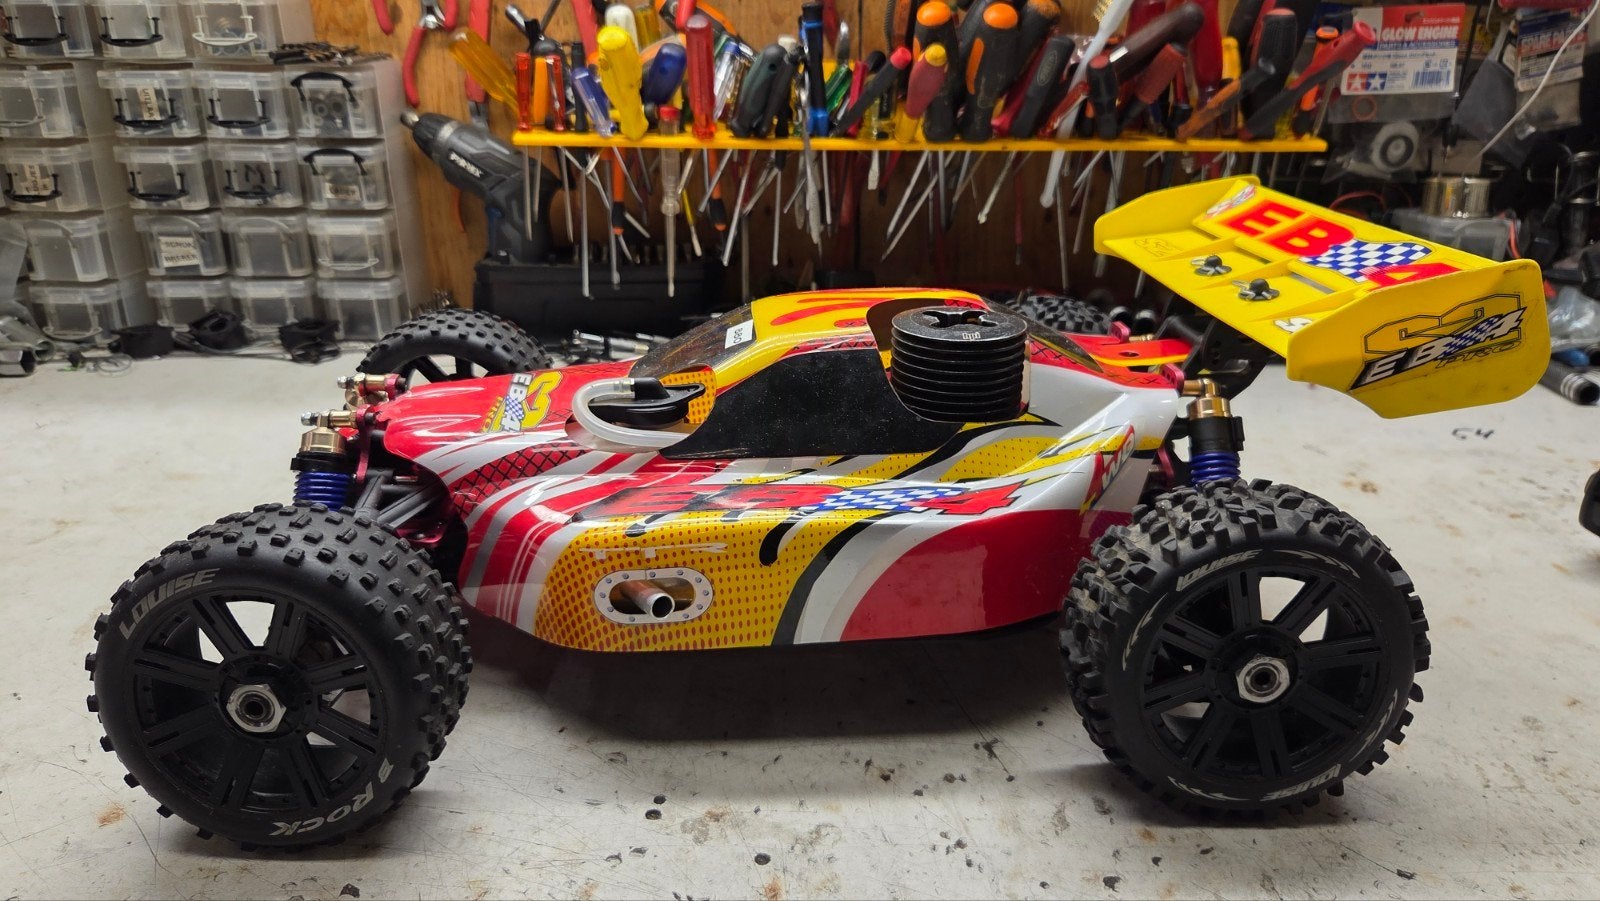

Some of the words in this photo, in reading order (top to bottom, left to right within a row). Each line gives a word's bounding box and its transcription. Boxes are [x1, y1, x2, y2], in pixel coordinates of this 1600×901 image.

[1381, 26, 1416, 41] GLOW
[1417, 25, 1459, 40] ENGINE
[1176, 549, 1261, 592] LOUISE
[118, 567, 221, 640] LOUISE
[1260, 763, 1342, 802] LOUISE
[269, 781, 376, 838] ROCK
